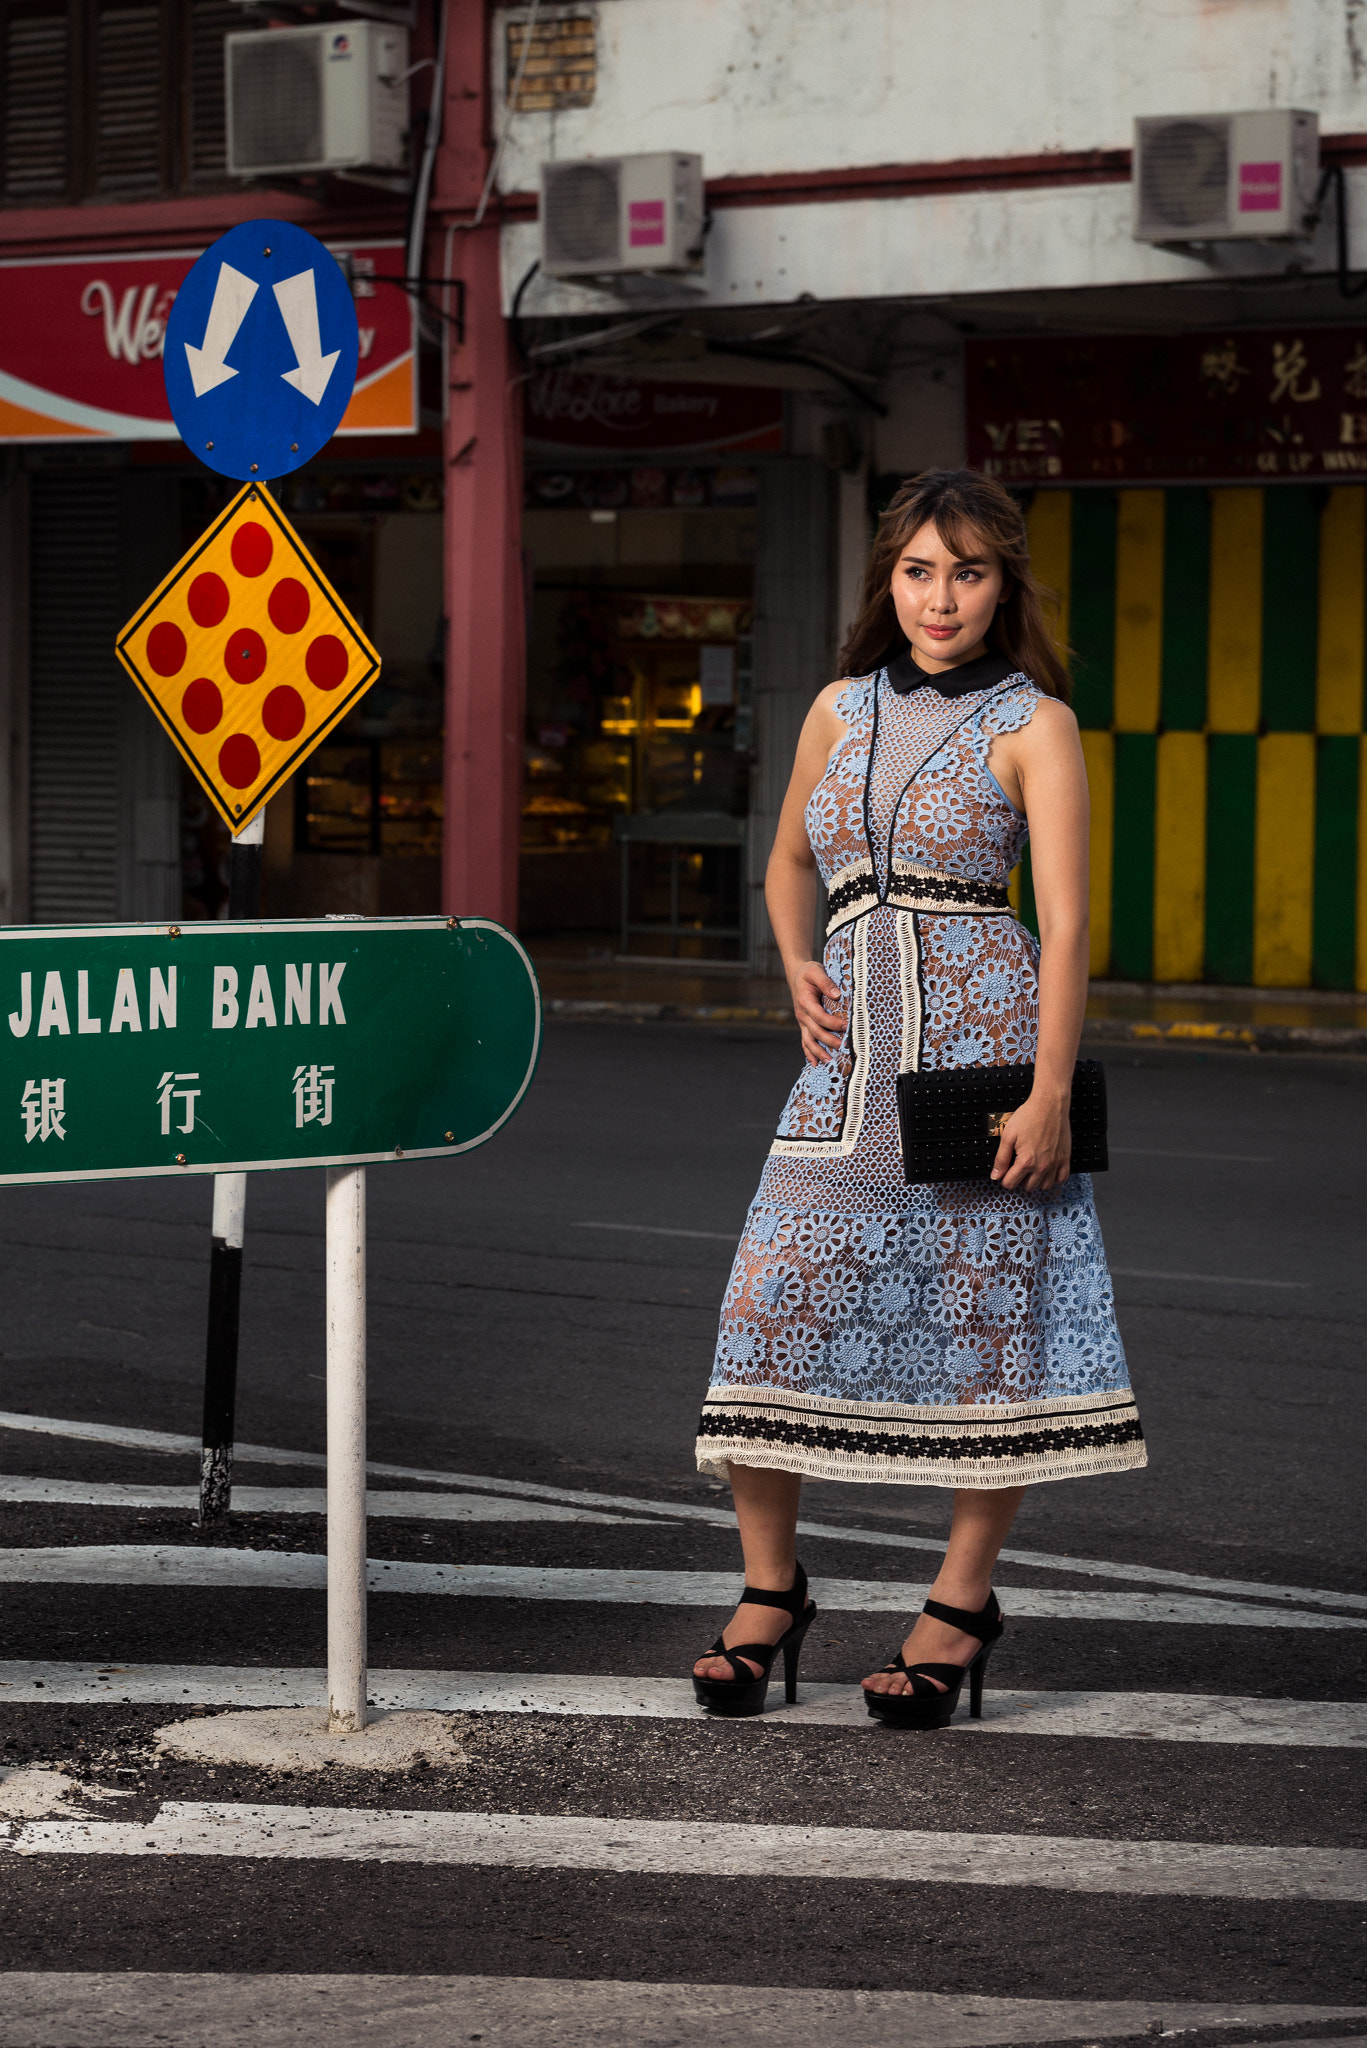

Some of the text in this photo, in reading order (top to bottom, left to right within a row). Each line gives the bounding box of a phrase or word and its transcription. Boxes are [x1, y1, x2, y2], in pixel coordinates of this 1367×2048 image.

[8, 962, 347, 1038] JALAN BANK
[20, 1064, 336, 1144] 银行街
